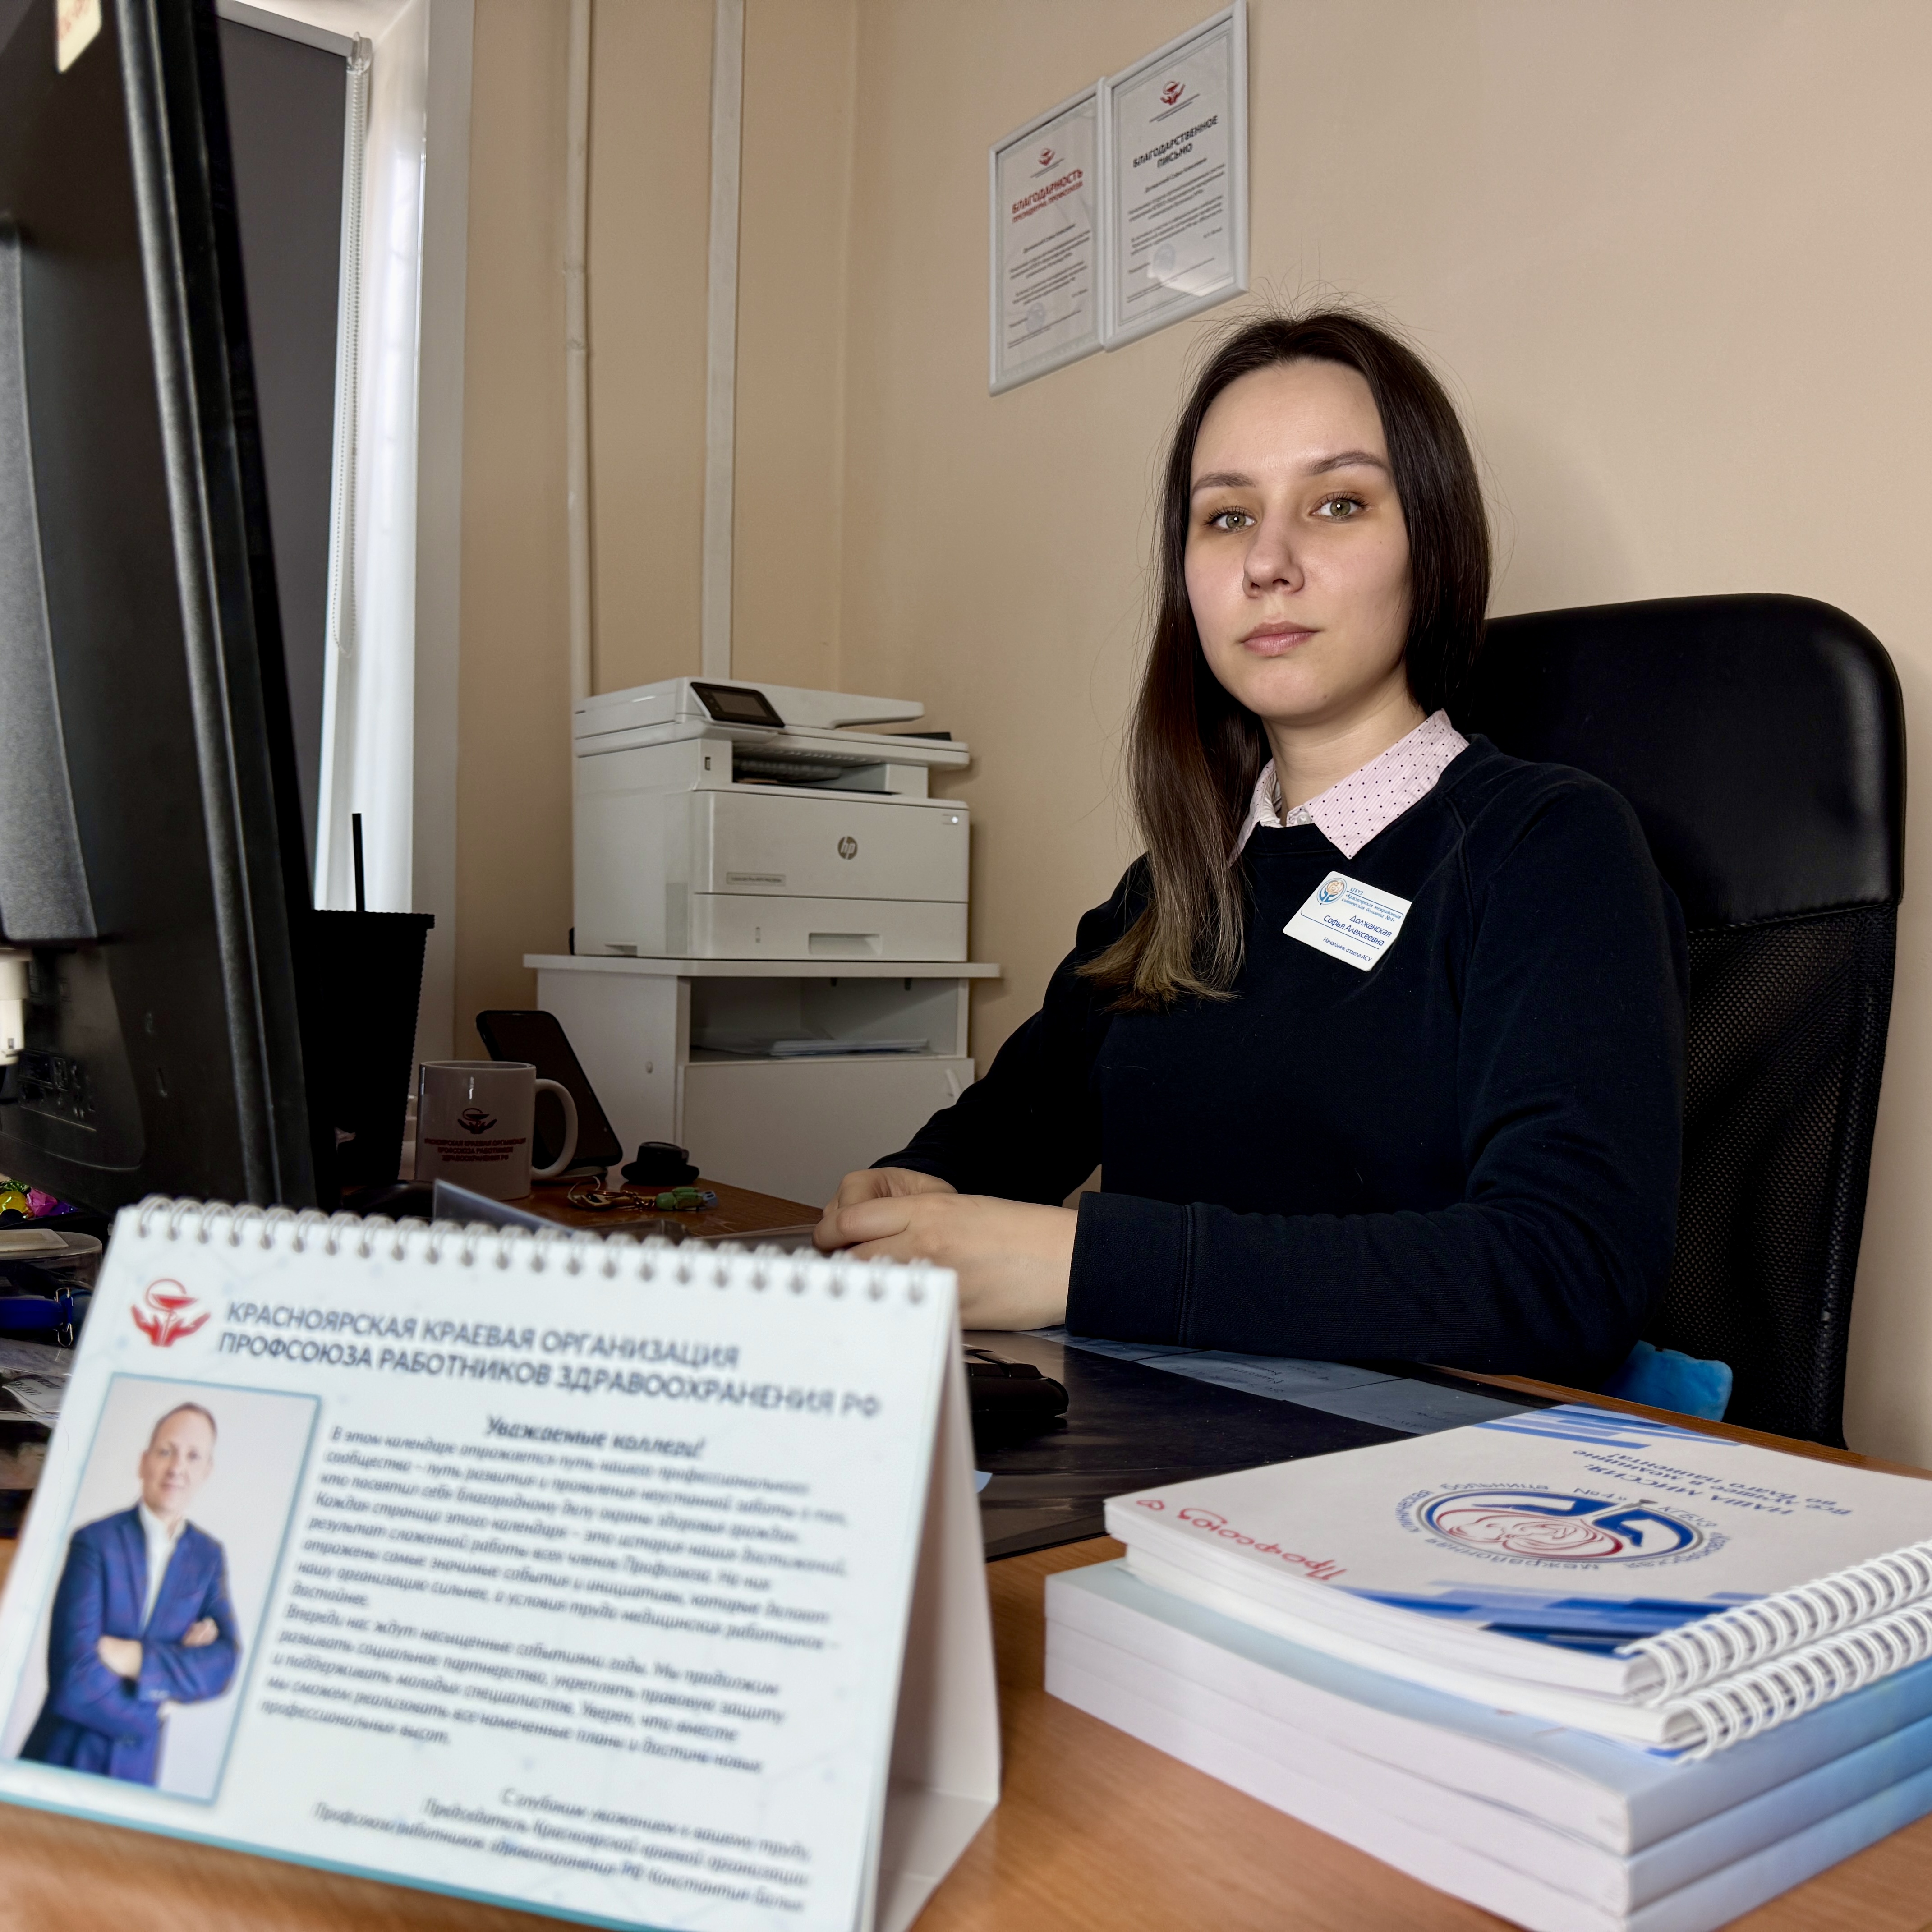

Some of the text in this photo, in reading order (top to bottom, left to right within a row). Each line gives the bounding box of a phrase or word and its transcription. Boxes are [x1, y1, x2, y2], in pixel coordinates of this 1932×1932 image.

[1132, 115, 1219, 168] БЛАГОДАРСТВЕННОЕ
[1157, 143, 1193, 168] ПИСЬМО
[1012, 168, 1084, 214] БЛАГОДАРНОСТЬ
[838, 836, 857, 860] hp
[1323, 915, 1385, 946] Софья Алексеевна
[1349, 915, 1392, 937] Должанская
[1323, 937, 1347, 951] Начальник
[1346, 948, 1361, 959] отдела
[227, 1304, 738, 1367] КРАСНОЯРСКАЯ КРАЕВАЯ ОРГАНИЗАЦИЯ
[220, 1334, 880, 1417] ПРОФСОЮЗА РАБОТНИКОВ ЗДРАВООХРАНЕНИЯ РФ
[486, 1416, 706, 1457] Уважаемые коллеги!
[1583, 1464, 1794, 1516] НАША МИССИЯ:
[1710, 1486, 1801, 1505] лучшее
[1729, 1483, 1797, 1500] благо
[1805, 1504, 1853, 1516] Все
[1176, 1508, 1347, 1582] Профсоюз
[1424, 1537, 1600, 1570] межрайонная
